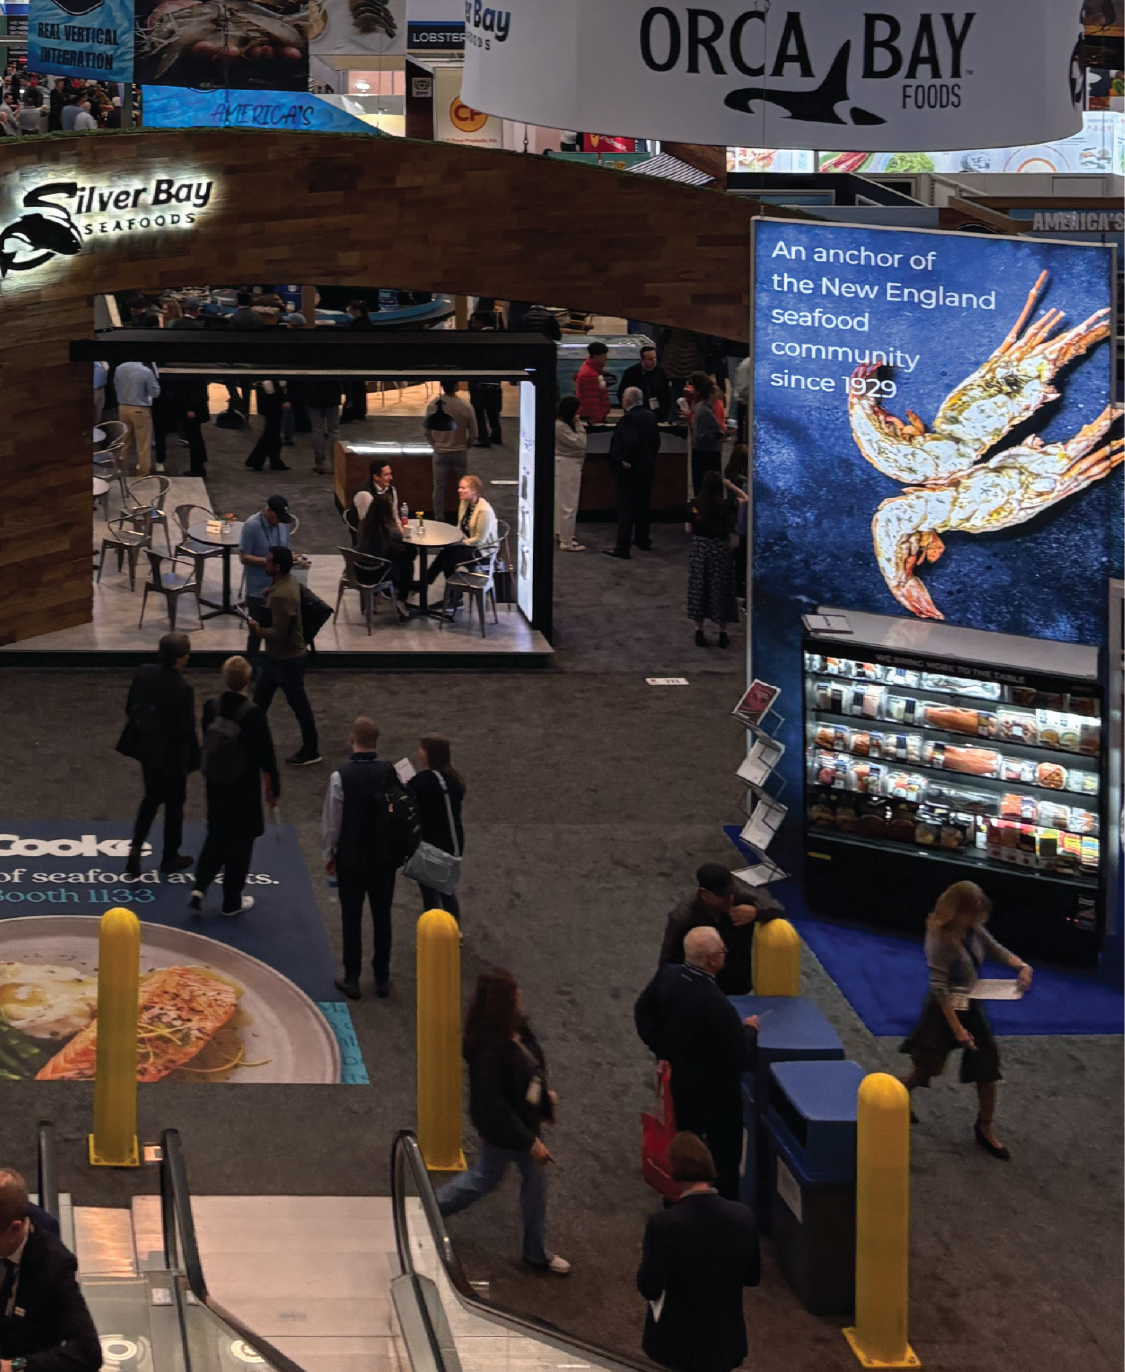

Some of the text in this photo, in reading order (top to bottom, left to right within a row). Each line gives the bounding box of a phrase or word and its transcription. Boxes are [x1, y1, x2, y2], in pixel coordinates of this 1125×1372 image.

[37, 22, 62, 40] REAL
[64, 25, 119, 46] VERTICAL
[640, 6, 815, 77] ORCA
[862, 12, 977, 80] BAY
[40, 46, 114, 70] INTEGRATION
[902, 84, 962, 109] FOODS
[210, 103, 315, 126] AMERICA'S
[23, 178, 213, 222] Silver Bay
[84, 212, 196, 235] SEAFOODS
[1032, 212, 1125, 231] AMERICA'S
[771, 240, 937, 270] An anchor of
[771, 272, 996, 310] the New England
[771, 308, 869, 332] seafood
[771, 341, 920, 373] community
[770, 370, 897, 399] since 1929
[31, 868, 161, 885] seafood
[88, 888, 156, 904] 1133
